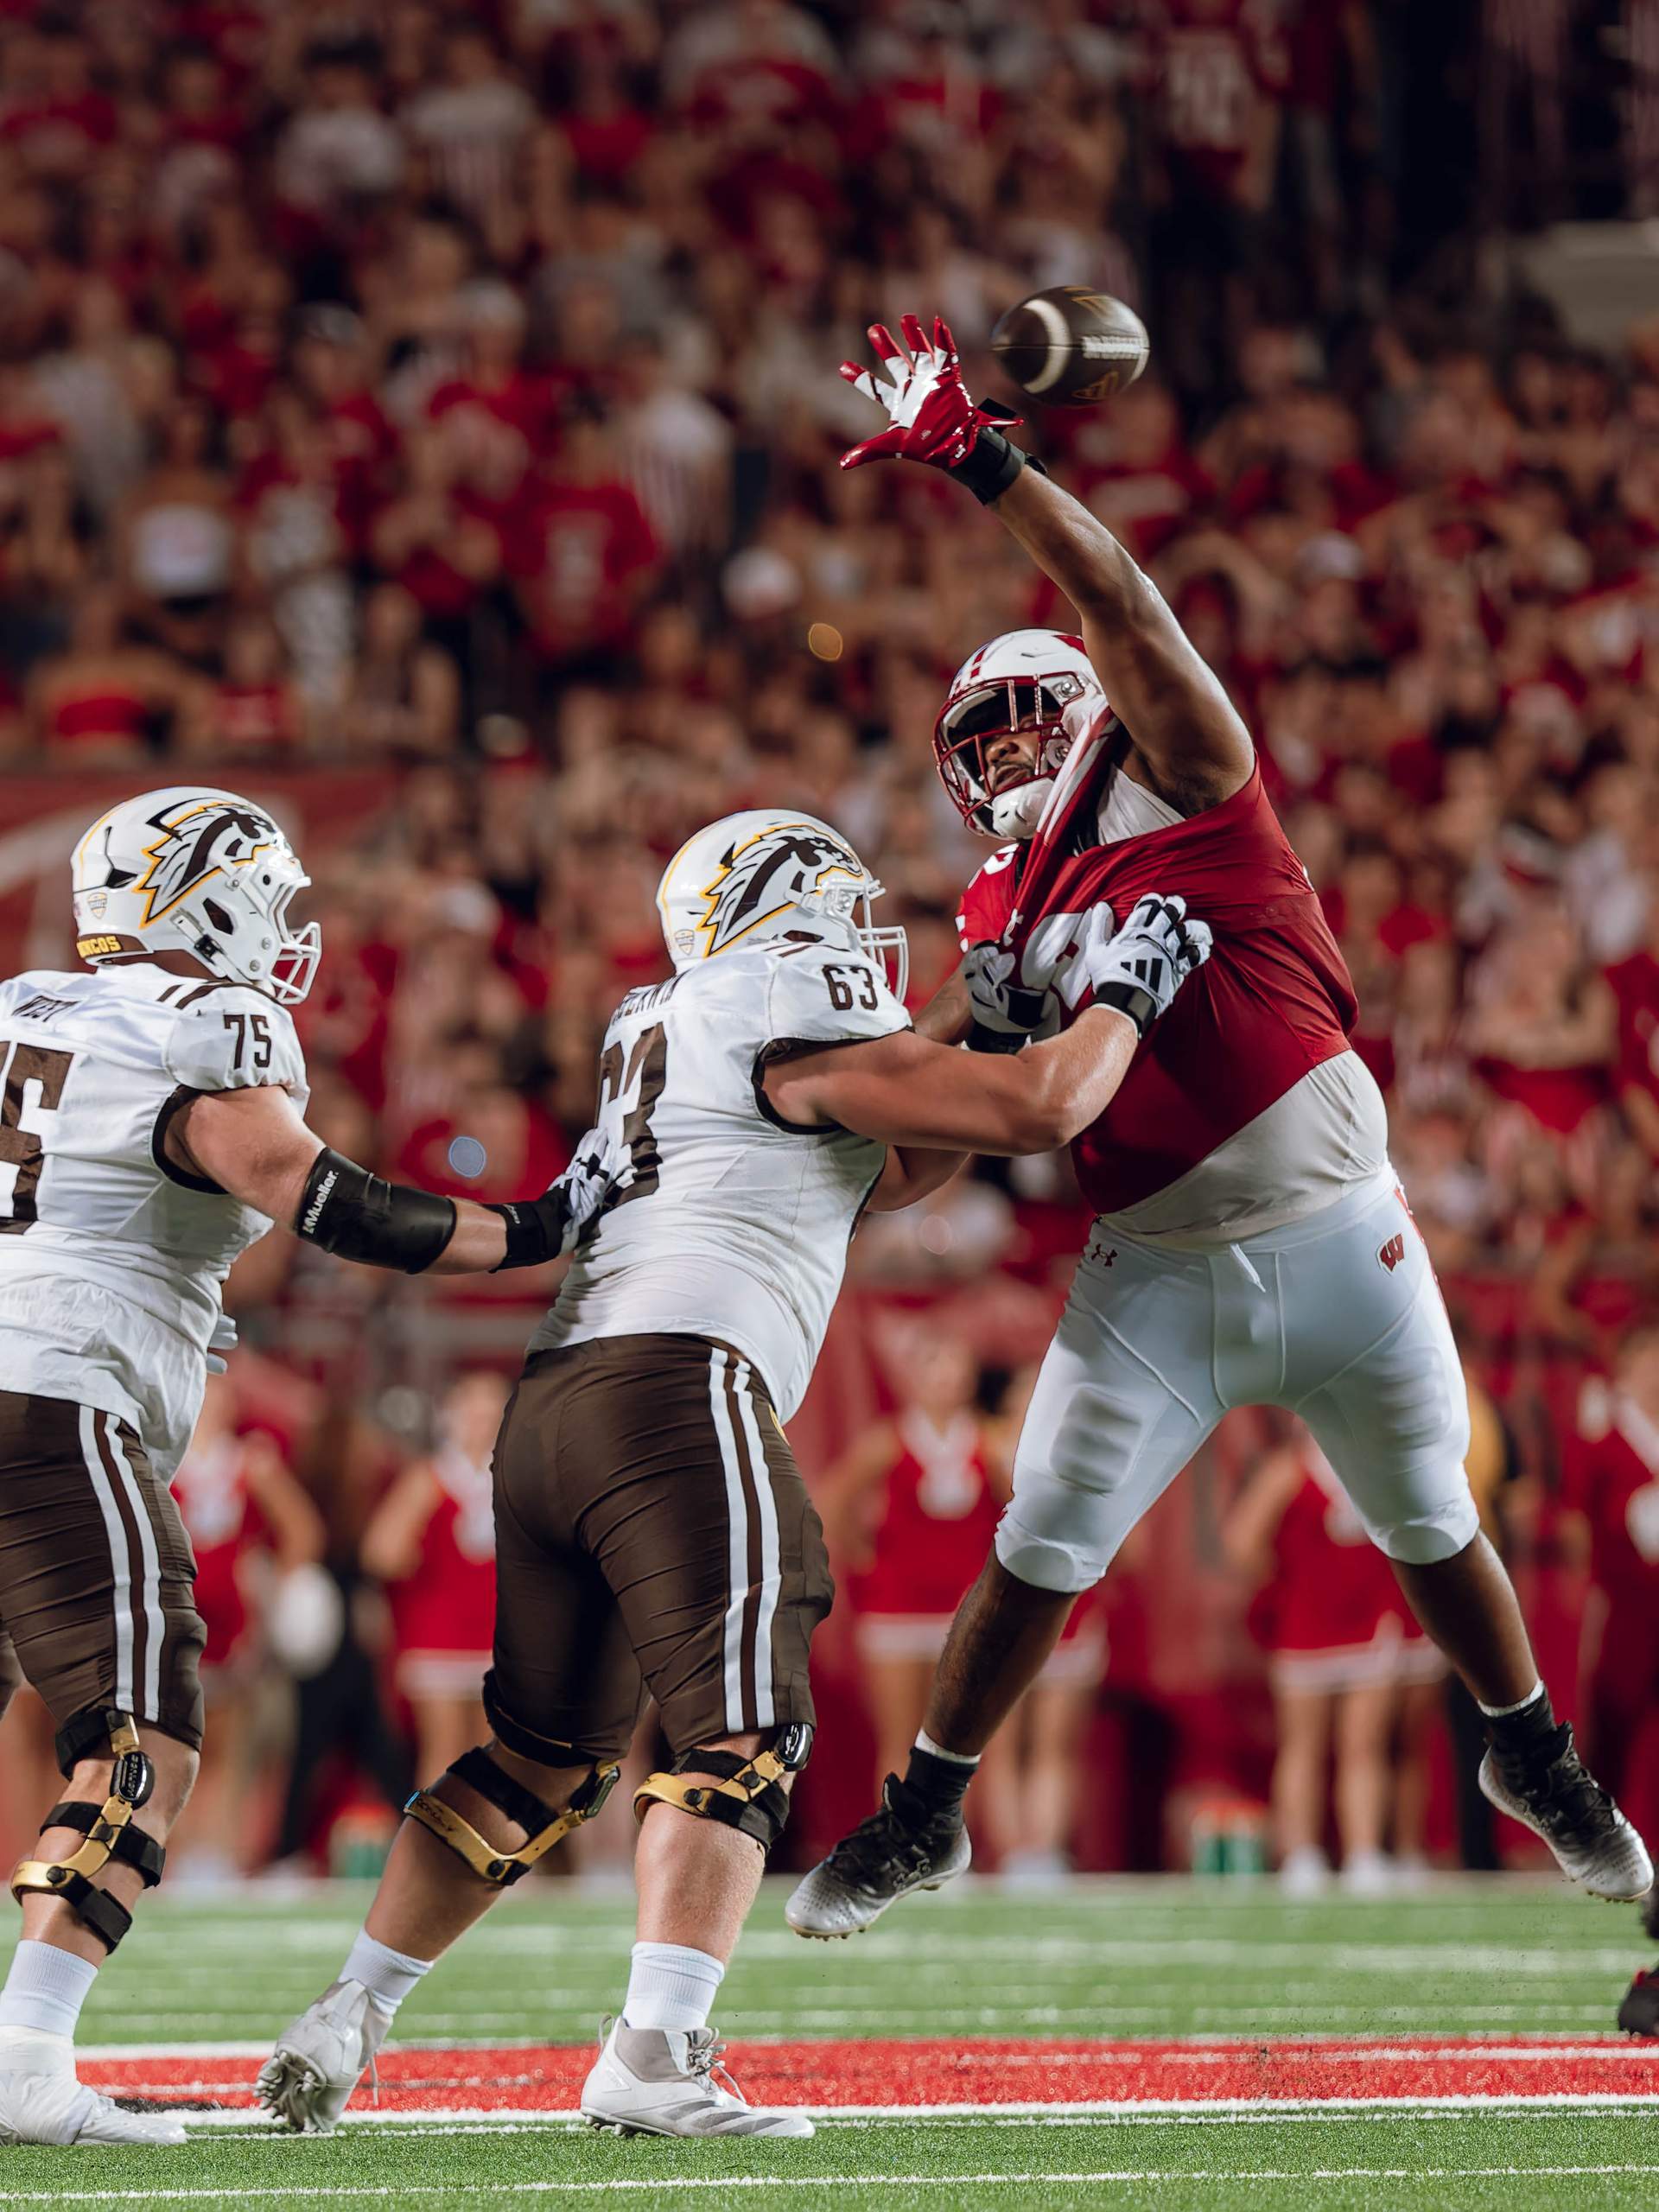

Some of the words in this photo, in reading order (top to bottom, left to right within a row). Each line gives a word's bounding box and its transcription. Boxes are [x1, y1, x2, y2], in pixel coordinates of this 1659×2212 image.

[821, 964, 878, 1011] 63
[223, 1014, 271, 1070] 75
[0, 1040, 74, 1235] 5
[304, 1170, 338, 1226] Mueller
[1380, 1233, 1405, 1272] W
